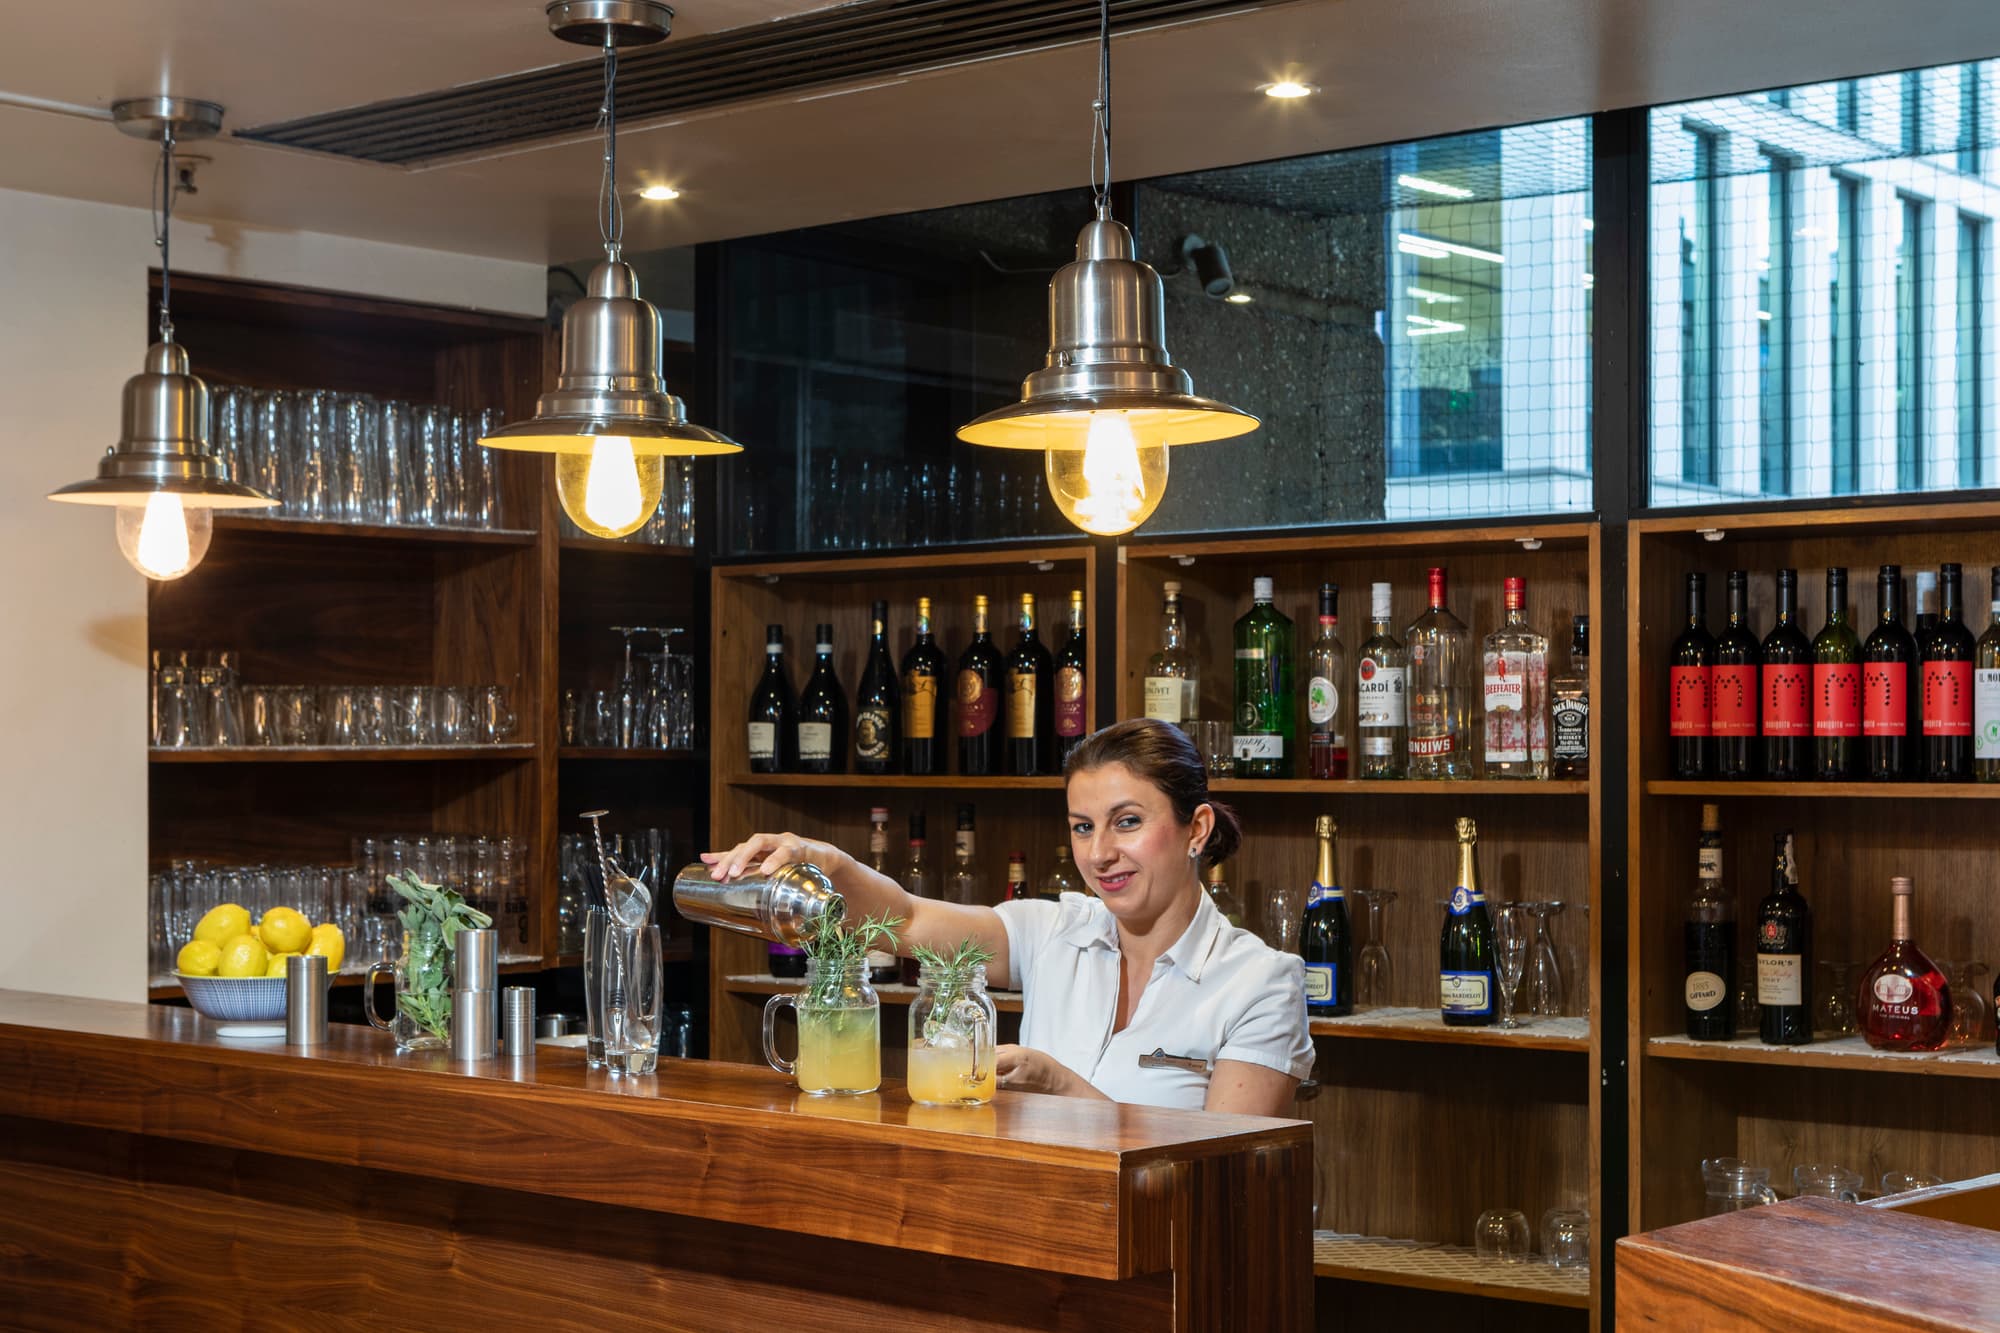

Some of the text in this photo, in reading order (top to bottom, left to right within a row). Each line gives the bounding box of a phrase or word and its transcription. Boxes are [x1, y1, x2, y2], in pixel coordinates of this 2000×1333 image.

[1358, 679, 1389, 693] CARDÍ
[1485, 683, 1521, 696] BEEFEATER
[1552, 701, 1567, 716] JACK
[1408, 738, 1451, 753] SMIRNO
[1872, 1003, 1919, 1015] MATEUS
